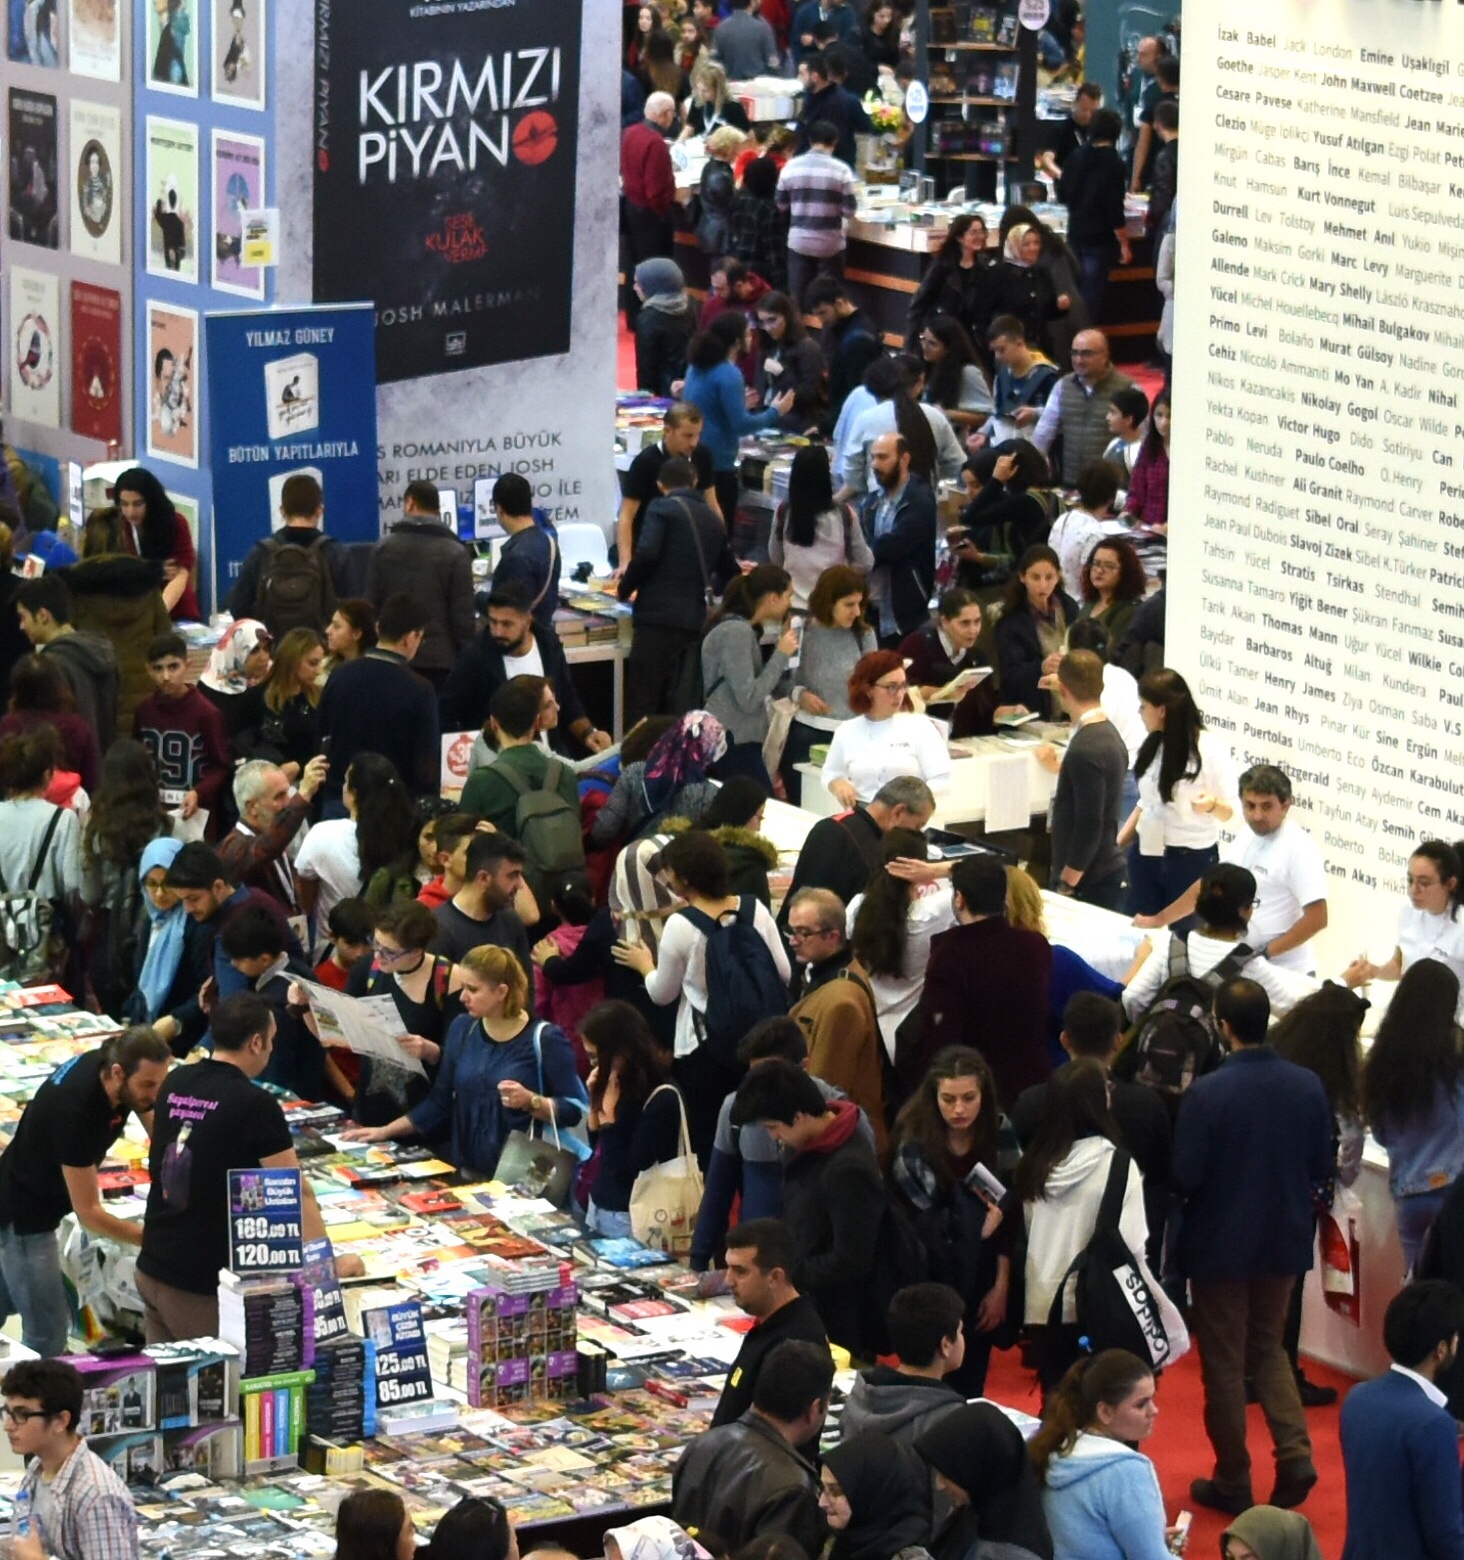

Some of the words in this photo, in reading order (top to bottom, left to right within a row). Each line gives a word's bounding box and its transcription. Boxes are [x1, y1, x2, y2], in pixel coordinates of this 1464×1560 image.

[358, 48, 561, 126] KIRMIZI
[1298, 186, 1321, 203] Kurt
[1324, 191, 1375, 215] Vonnegut
[425, 228, 484, 251] KULAK
[374, 306, 423, 327] JOSH
[246, 328, 290, 347] YILMAZ
[295, 327, 334, 344] GÜNEY
[1301, 392, 1341, 416] Nikolay
[1347, 402, 1378, 422] Gogol
[1277, 416, 1309, 434] Victor
[1313, 424, 1340, 444] Hugo
[229, 445, 269, 463] BÜTÜN
[274, 440, 359, 460] YAPITLARIYLA
[392, 439, 497, 459] ROMANIYLA
[504, 430, 562, 450] BÜYÜK
[408, 468, 449, 483] ELDE
[455, 464, 501, 480] EDEN
[1296, 449, 1325, 467] Paulo
[1329, 456, 1364, 476] Coelho
[559, 480, 582, 495] İLE
[1262, 613, 1302, 636] Thomas
[1309, 626, 1337, 645] Mann
[1265, 671, 1296, 694] Henry
[1303, 682, 1335, 702] James
[1439, 689, 1463, 707] Paul
[287, 1222, 300, 1237] TL
[237, 1244, 286, 1266] 120,00
[288, 1249, 300, 1263] TL
[416, 1354, 427, 1369] TL
[379, 1379, 416, 1401] 85,00
[417, 1380, 427, 1395] TL
